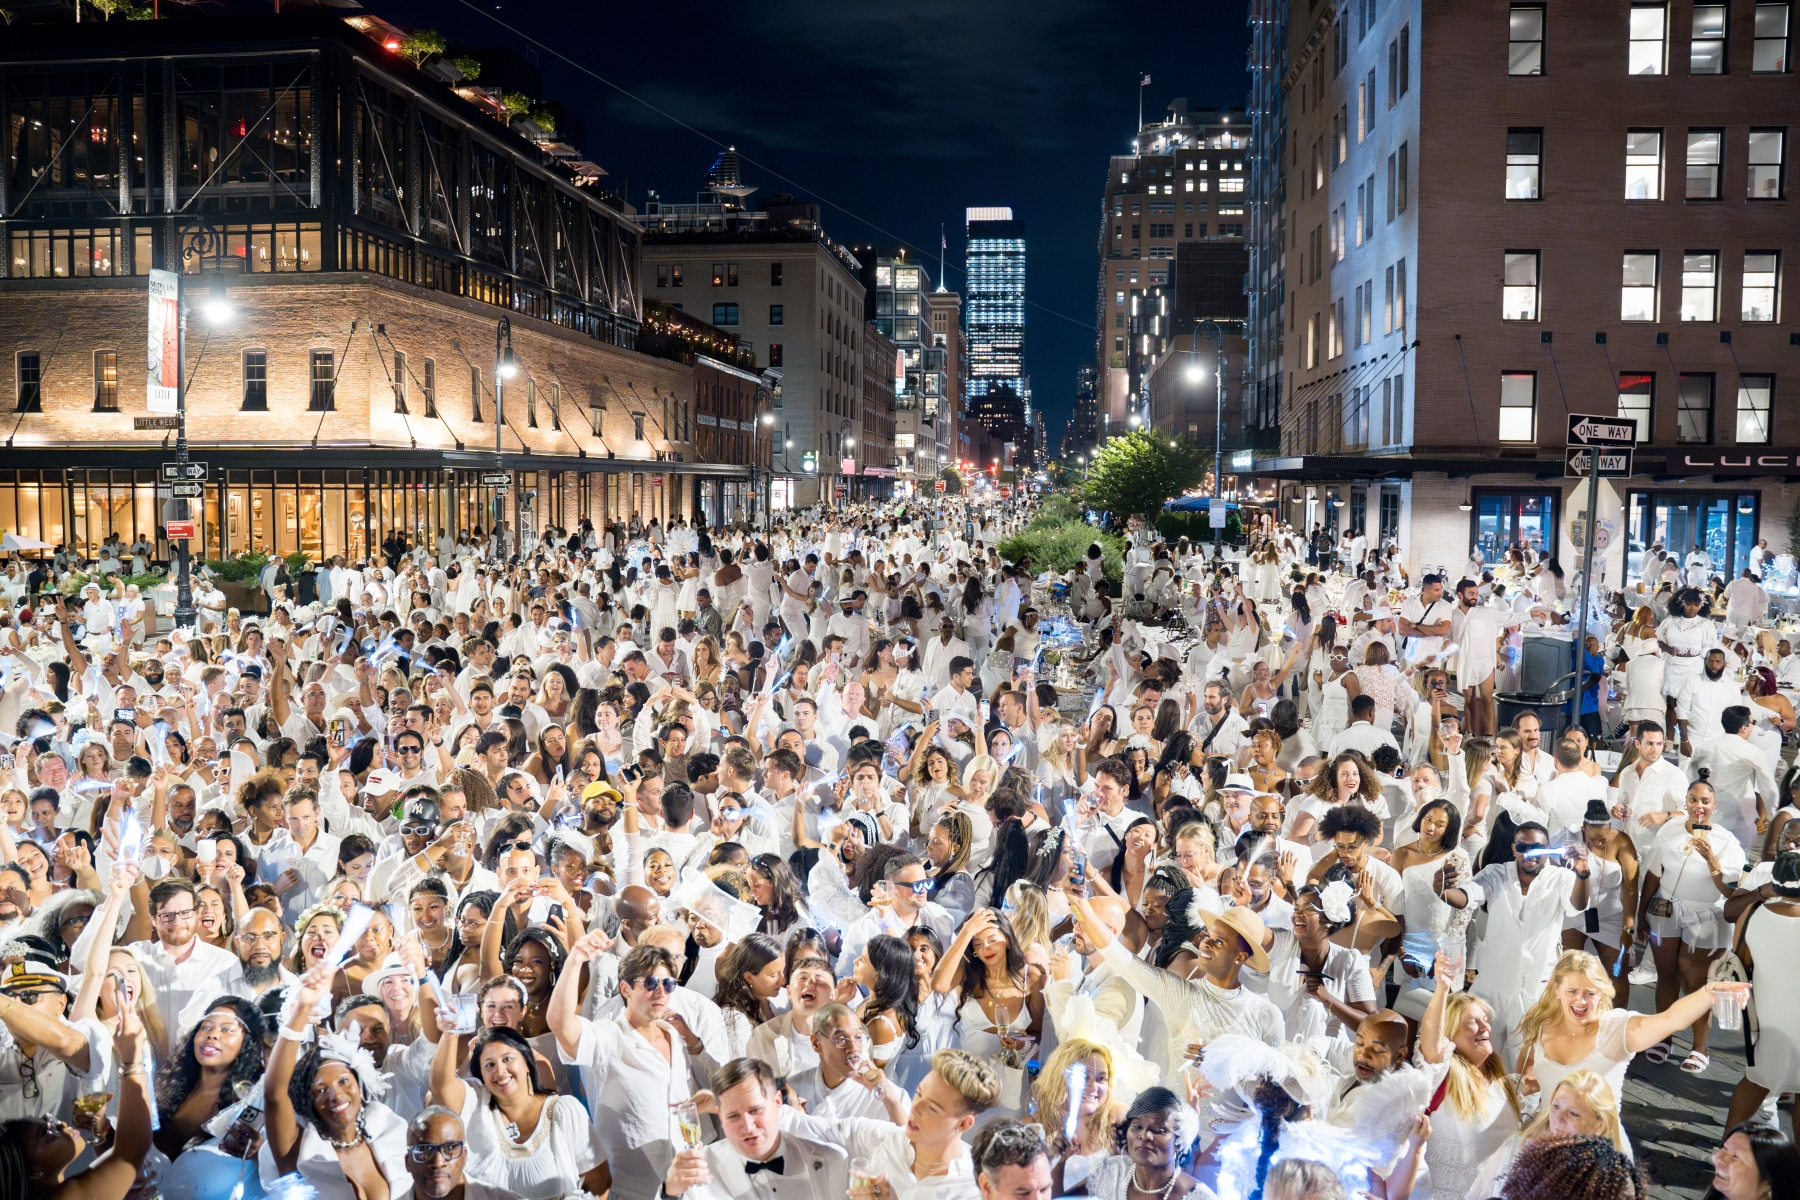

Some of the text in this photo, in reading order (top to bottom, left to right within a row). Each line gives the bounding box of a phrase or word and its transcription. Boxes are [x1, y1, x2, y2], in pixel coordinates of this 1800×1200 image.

[159, 418, 177, 426] WEST
[1579, 424, 1628, 439] ONE WAY
[1574, 457, 1622, 469] ONE WAY
[176, 486, 200, 494] ONE WAY
[411, 802, 424, 815] NY
